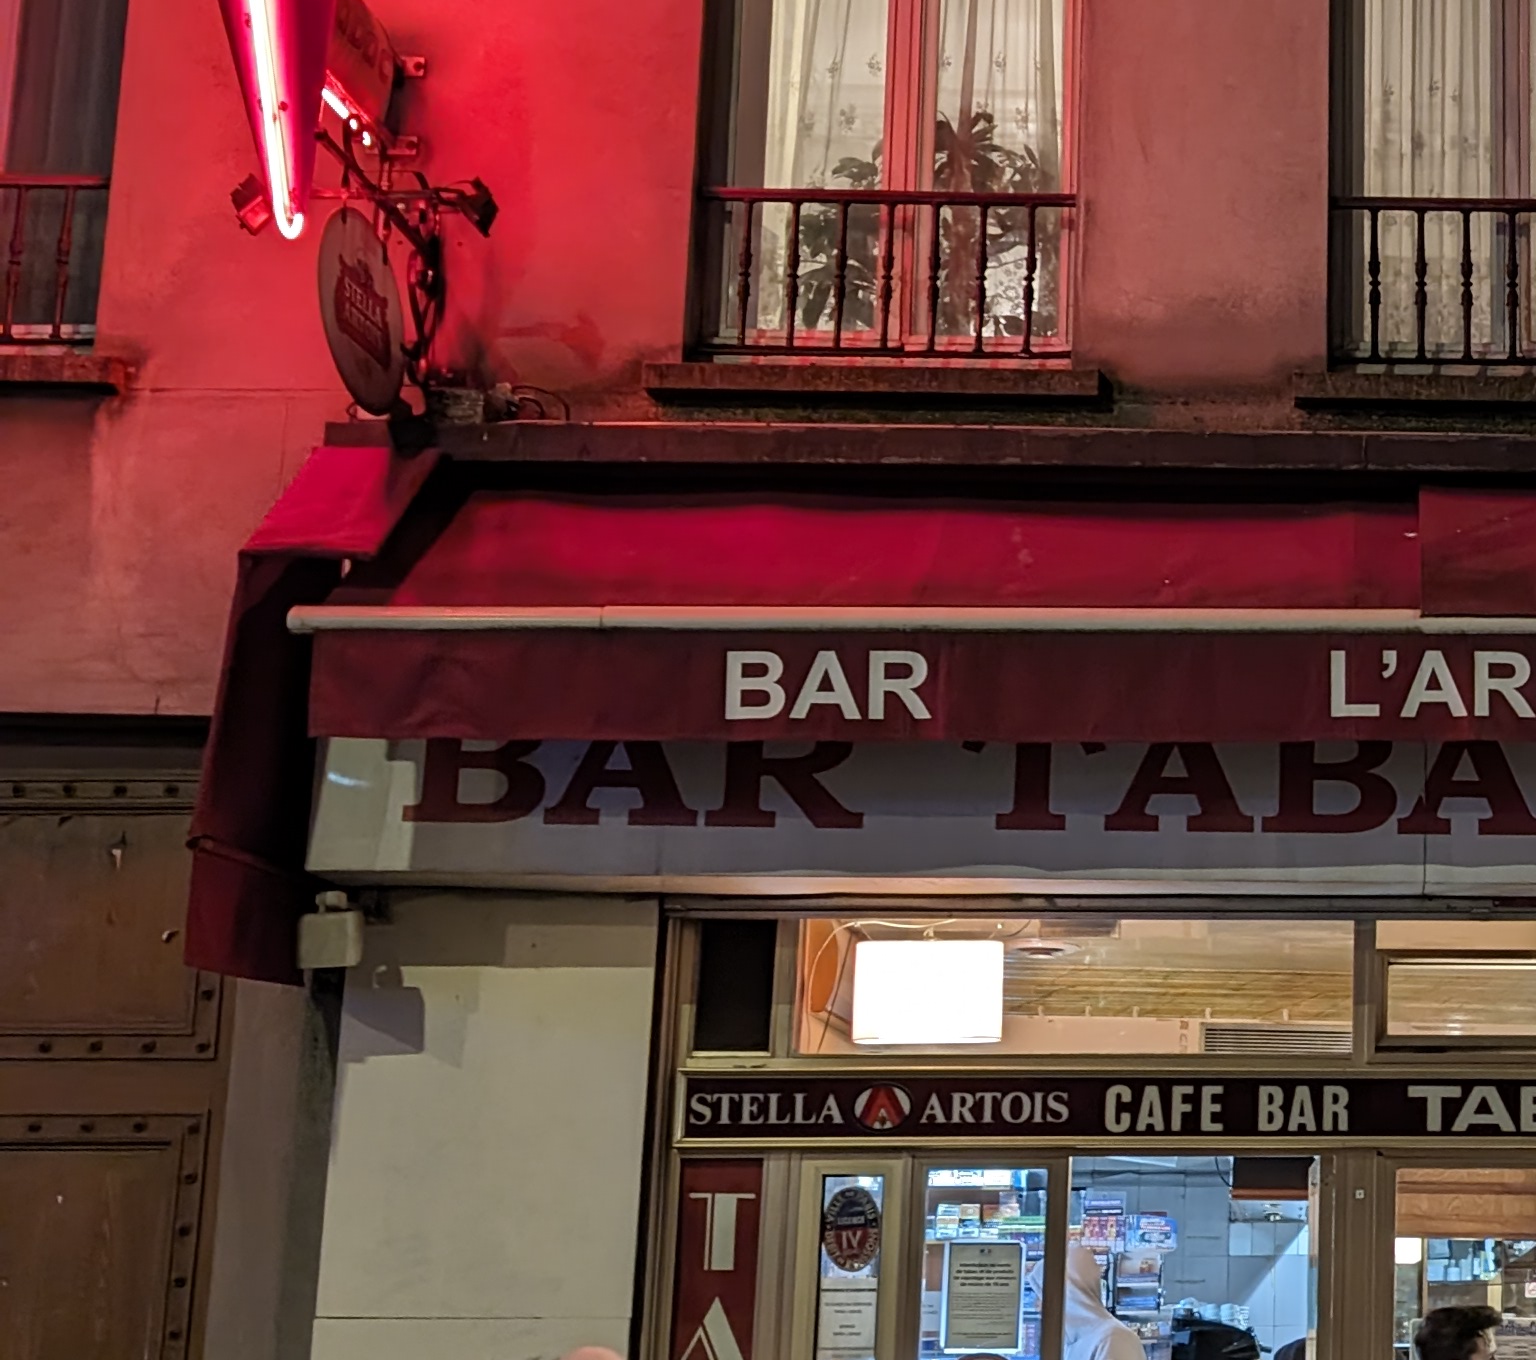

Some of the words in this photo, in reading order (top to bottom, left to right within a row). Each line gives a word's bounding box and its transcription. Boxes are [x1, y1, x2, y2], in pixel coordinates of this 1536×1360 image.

[723, 649, 932, 722] BAR
[401, 737, 864, 829] BAR
[689, 1091, 844, 1127] STELLA
[920, 1091, 1070, 1126] ARTOIS
[1104, 1084, 1225, 1133] CAFE
[1257, 1084, 1350, 1133] BAR
[841, 1230, 864, 1250] IV
